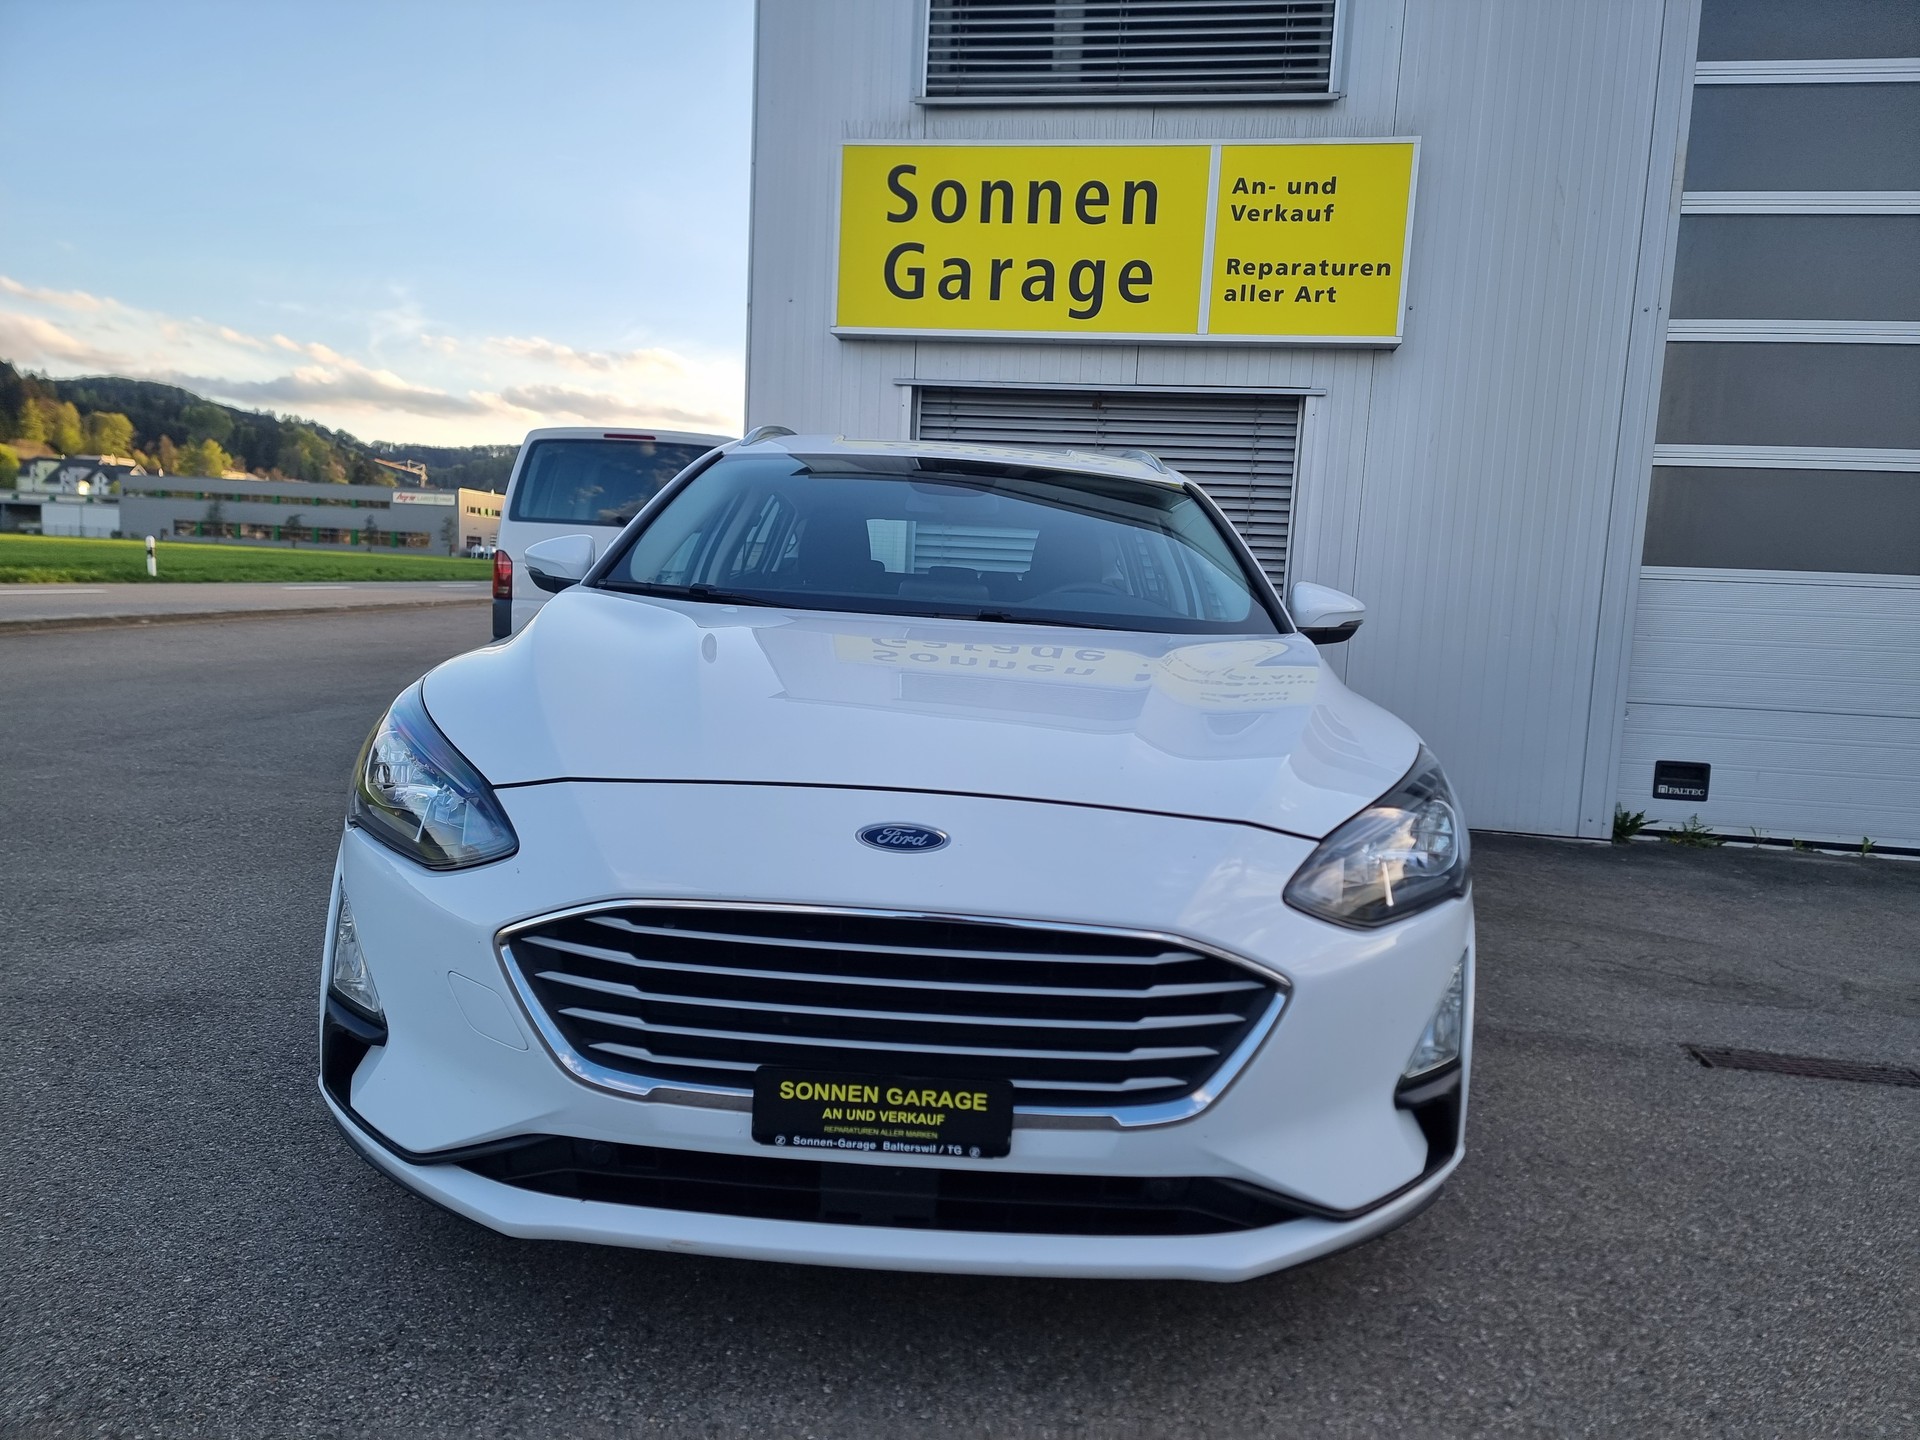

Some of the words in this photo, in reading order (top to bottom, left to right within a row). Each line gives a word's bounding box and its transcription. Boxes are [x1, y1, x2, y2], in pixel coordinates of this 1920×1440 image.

[886, 164, 1158, 225] Sonnen
[1231, 177, 1276, 195] An-
[1287, 176, 1337, 195] und
[1230, 203, 1335, 223] Verkauf
[1226, 258, 1391, 280] Reparaturen
[883, 242, 1153, 320] Garage
[1223, 284, 1285, 303] aller
[1294, 285, 1337, 303] Art
[1668, 787, 1705, 796] FALTEC
[877, 828, 928, 846] Ford
[780, 1081, 879, 1103] SONNEN
[886, 1087, 988, 1111] GARAGE
[822, 1108, 842, 1120] AN
[846, 1109, 876, 1122] UND
[879, 1111, 945, 1126] VERKAUF
[824, 1125, 879, 1136] REPARATUREN
[793, 1136, 877, 1151] Sonnen-Garage
[883, 1141, 936, 1154] Balterswil
[947, 1145, 962, 1155] TG
